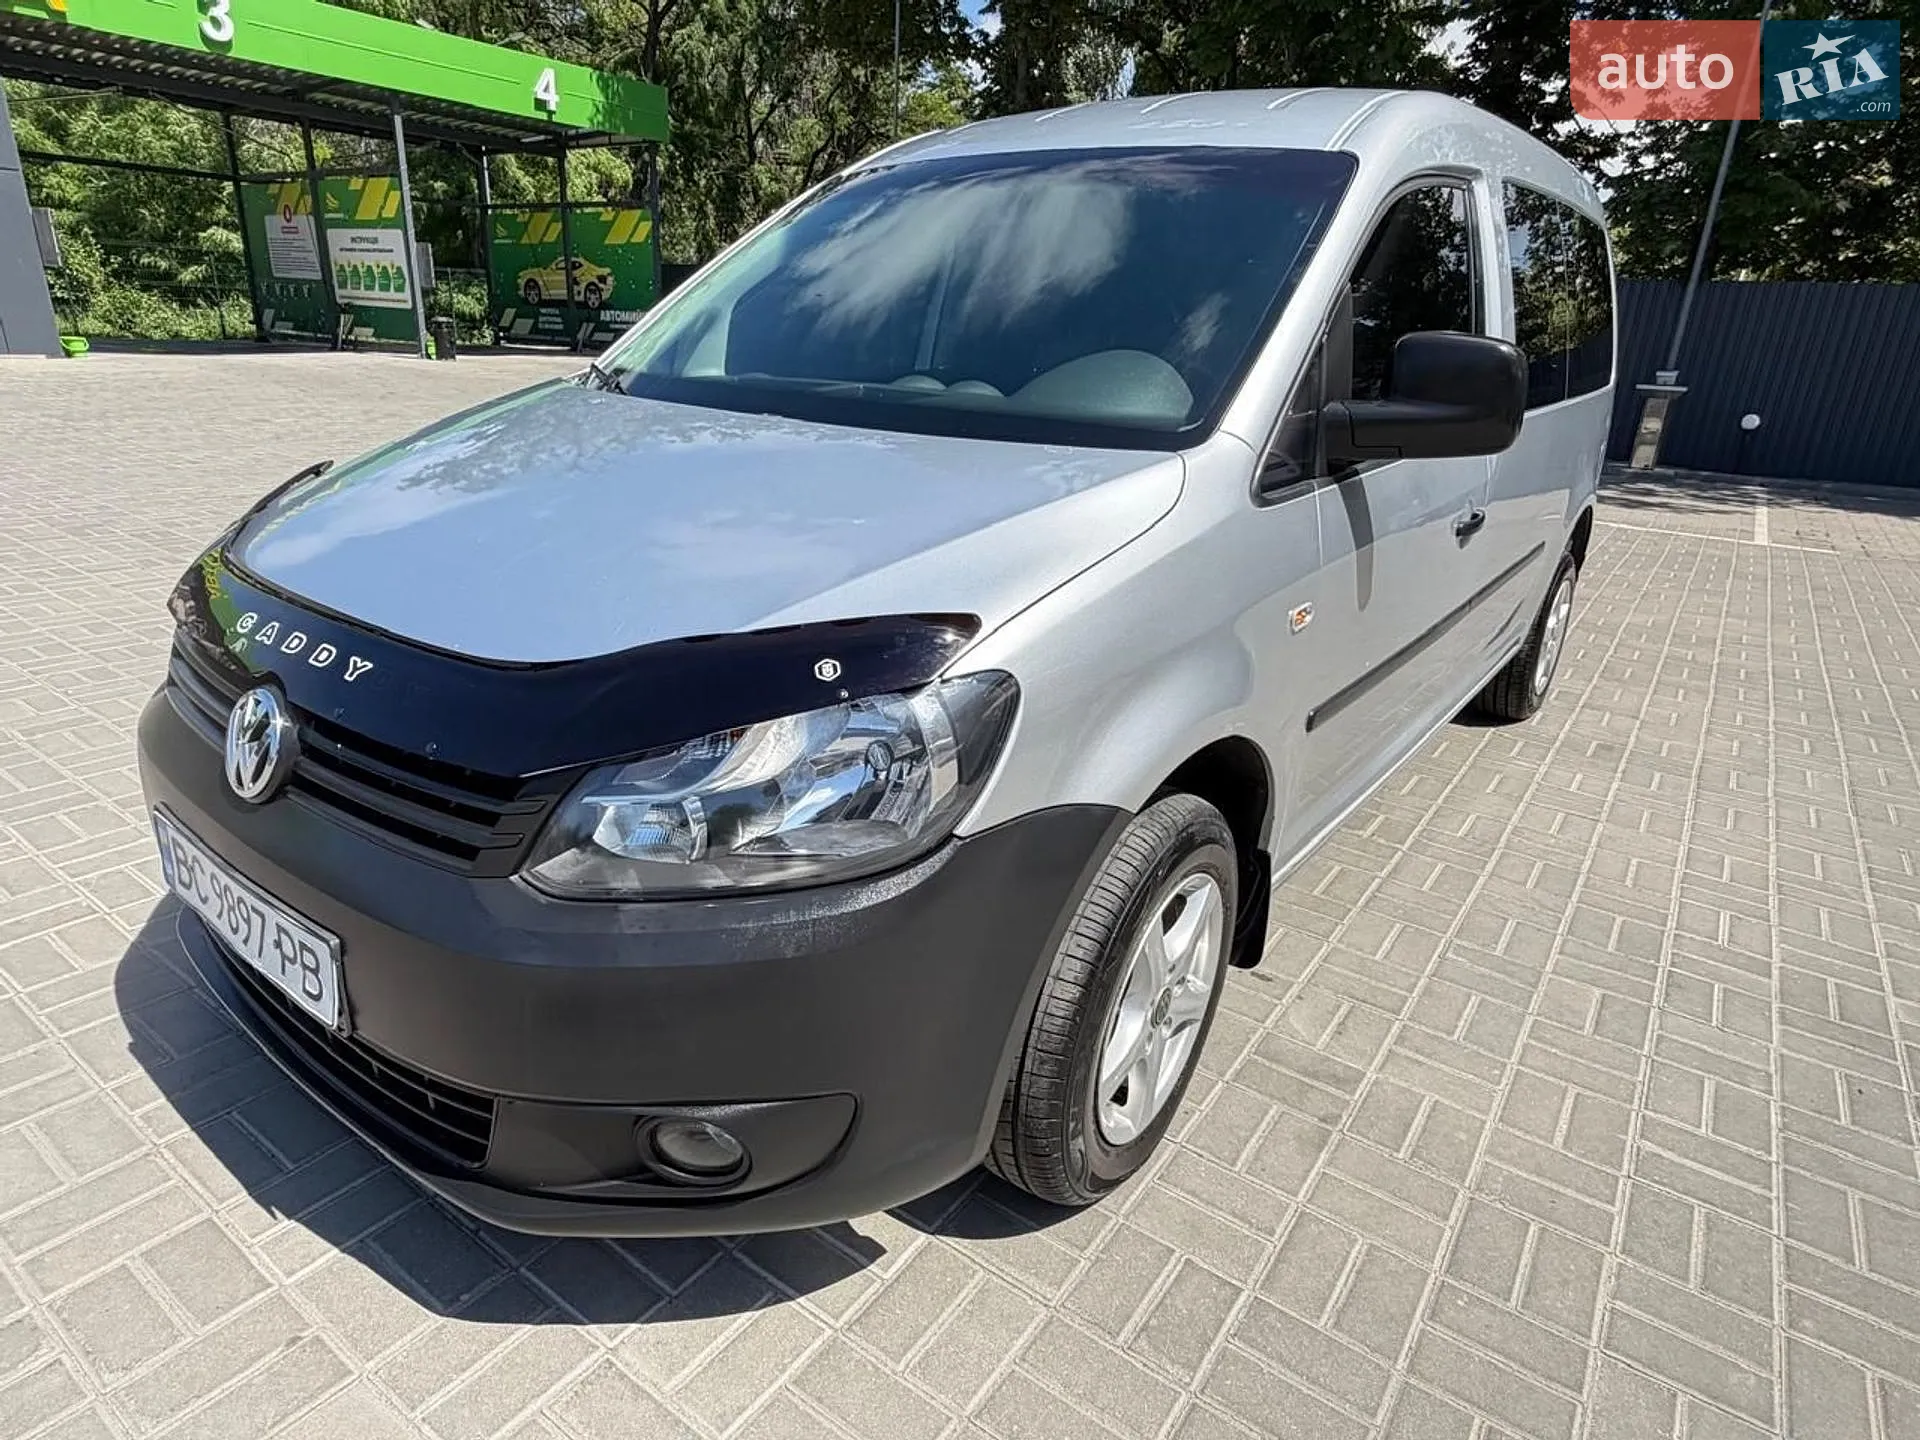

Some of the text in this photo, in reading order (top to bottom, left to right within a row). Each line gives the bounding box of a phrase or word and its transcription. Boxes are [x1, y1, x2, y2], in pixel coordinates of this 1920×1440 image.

[199, 0, 234, 41] 3
[533, 68, 560, 111] 4
[236, 612, 374, 682] CADDY
[171, 836, 324, 1002] BC 9897 PB
